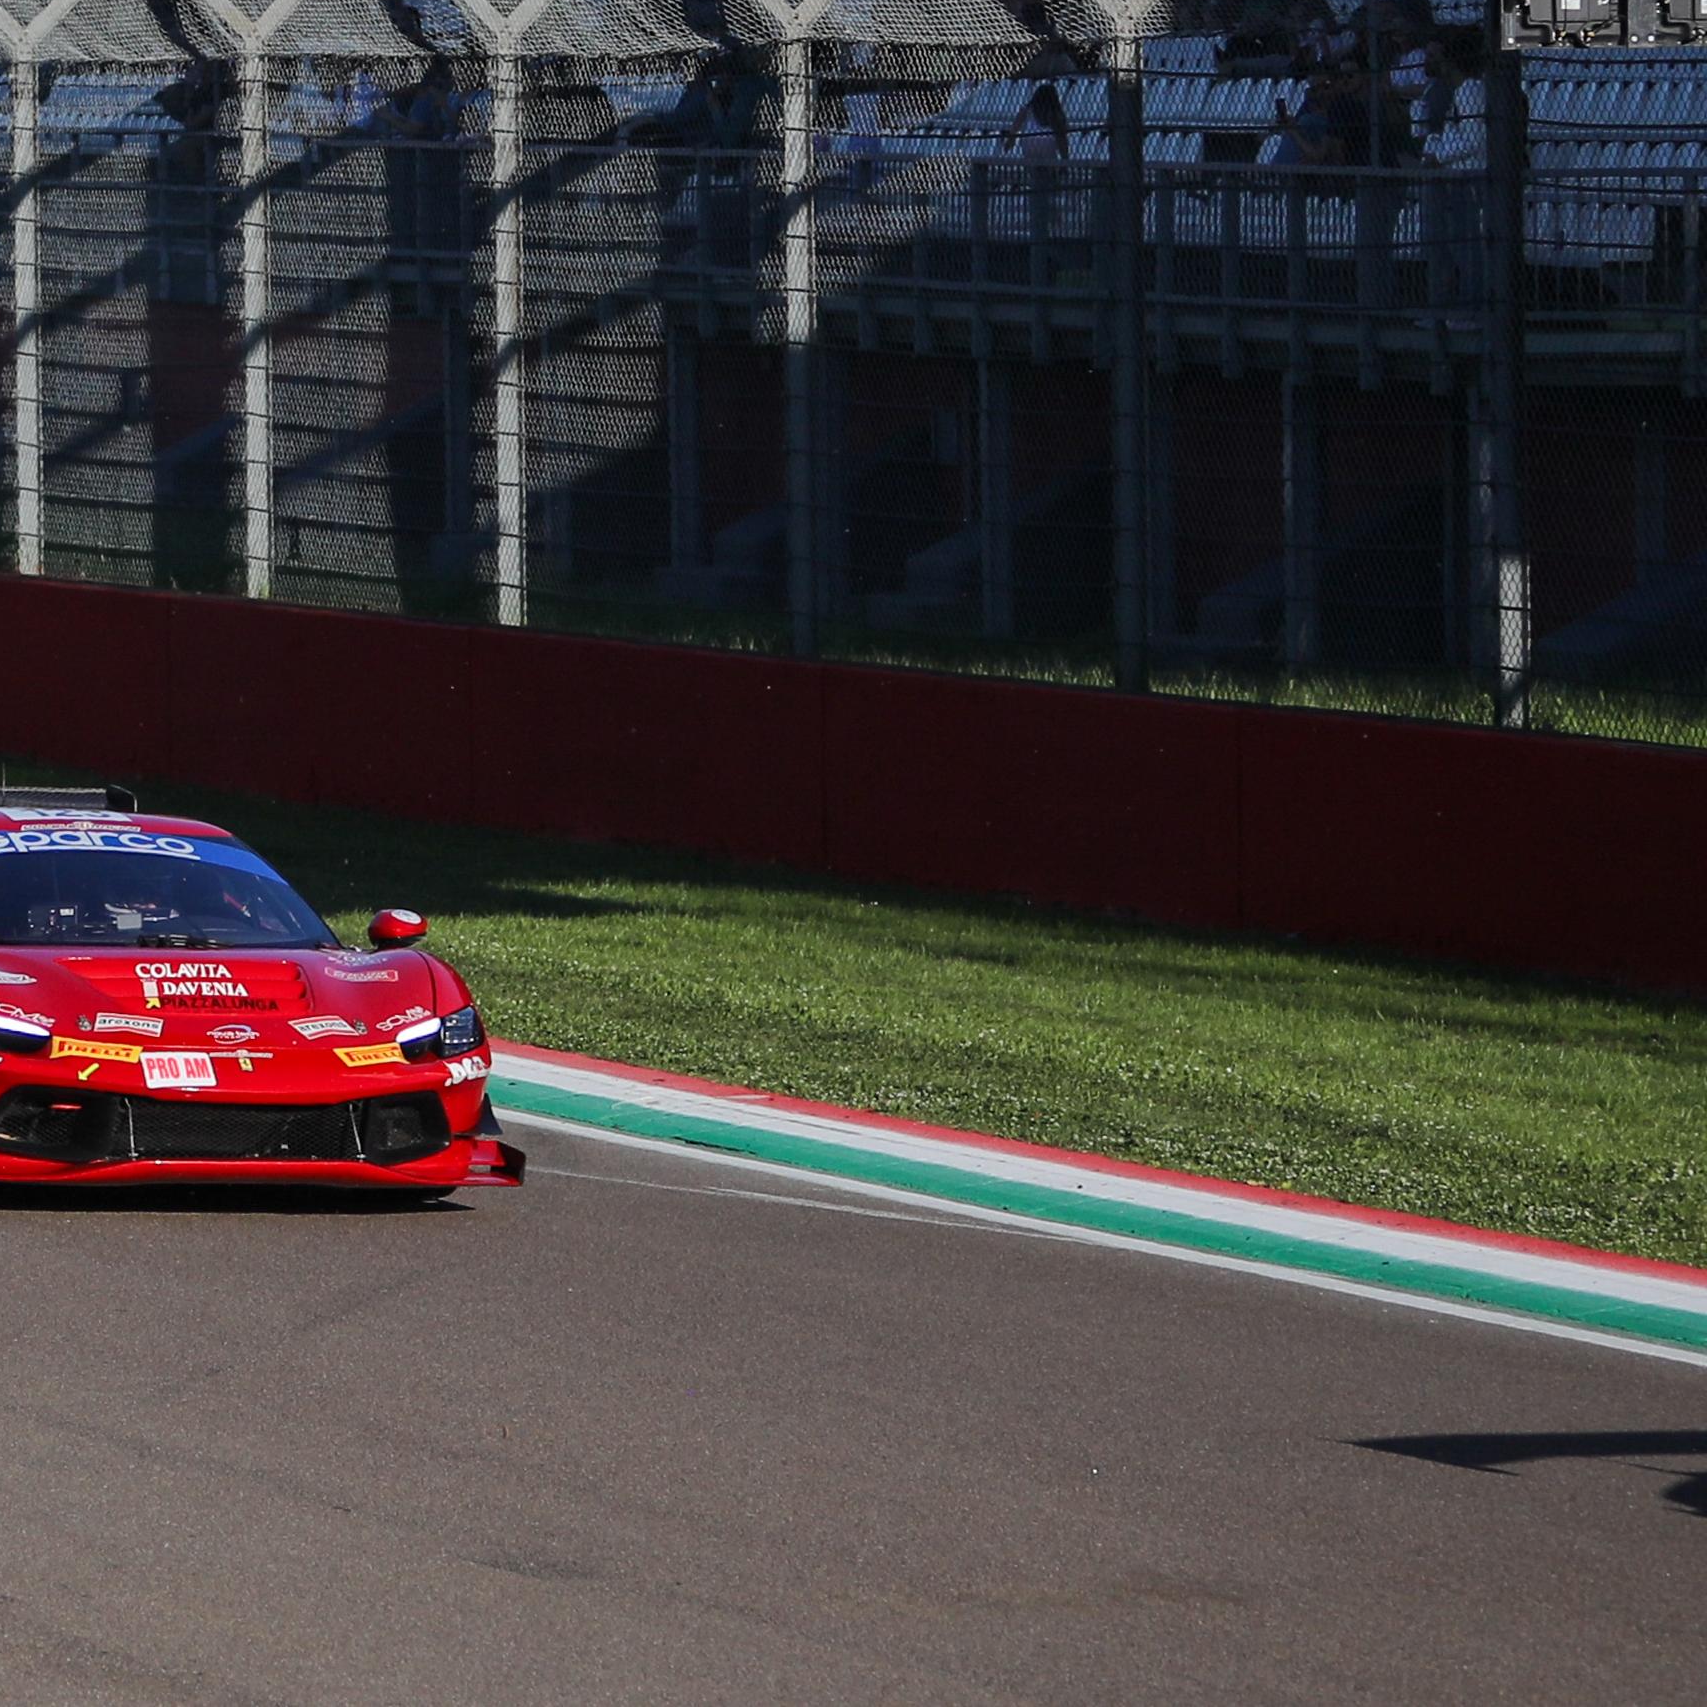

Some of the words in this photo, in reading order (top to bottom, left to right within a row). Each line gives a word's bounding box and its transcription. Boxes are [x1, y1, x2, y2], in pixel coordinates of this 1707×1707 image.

[135, 963, 232, 979] COLAVITA
[162, 981, 249, 997] DAVENIA
[160, 997, 280, 1012] PIAZZALUNGA
[97, 1016, 161, 1031] arexons
[59, 1041, 134, 1059] PIRELLI
[346, 1049, 402, 1064] PIRELLI
[145, 1057, 180, 1080] PRO
[185, 1057, 212, 1079] AM
